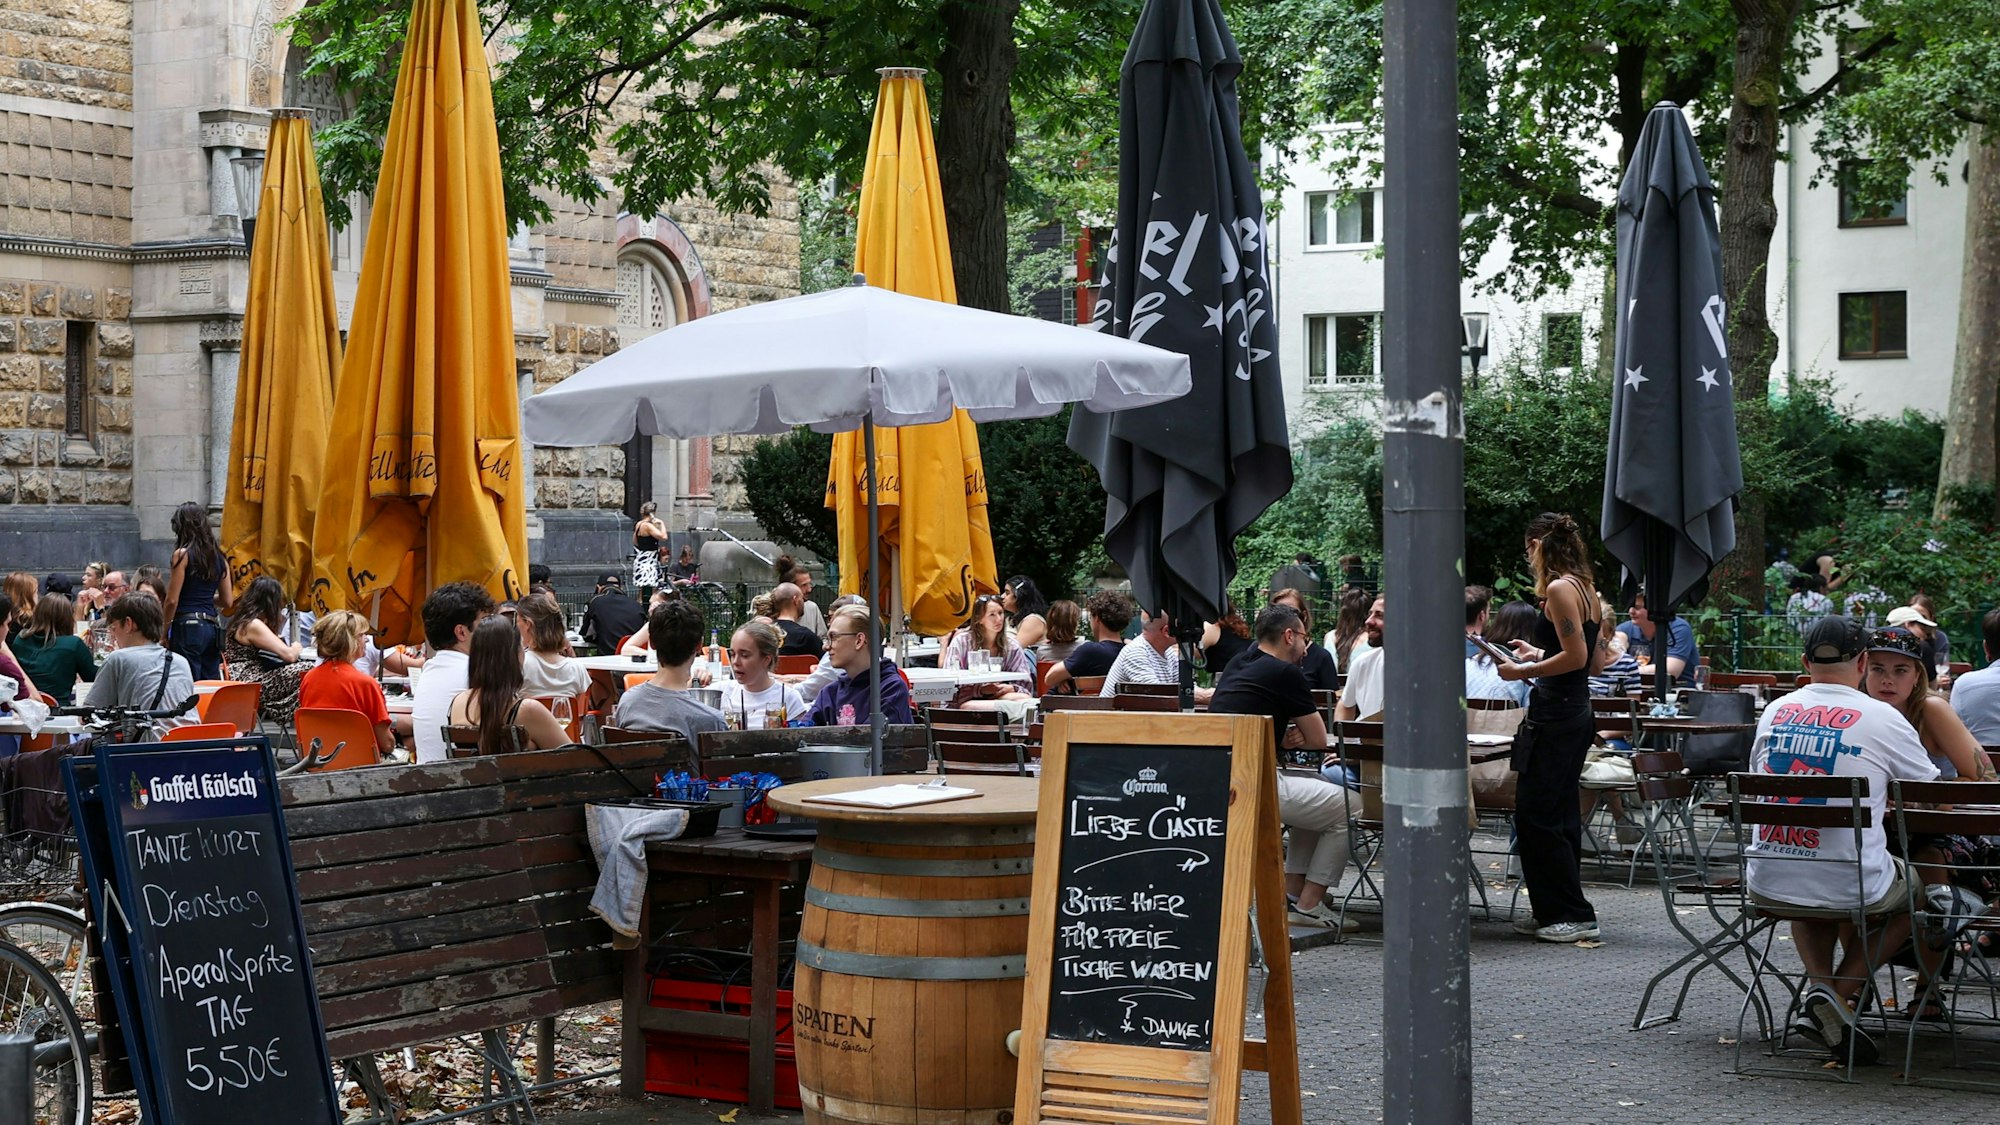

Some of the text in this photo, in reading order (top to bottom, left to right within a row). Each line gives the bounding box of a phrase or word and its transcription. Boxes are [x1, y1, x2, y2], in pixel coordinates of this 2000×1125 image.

[1771, 703, 1862, 730] DYNO
[1794, 727, 1816, 735] TOUR
[150, 770, 258, 804] Gaffel Kölsch
[1122, 777, 1169, 797] Corona
[1148, 795, 1225, 840] GÄSTE
[127, 826, 262, 870] TANTE KURT
[1759, 824, 1821, 849] VANS
[1773, 845, 1818, 858] LEGENDS
[142, 883, 270, 928] Dienstag
[1060, 922, 1103, 949] FÜR
[1058, 954, 1213, 982] TISCHE WARTEN
[196, 994, 253, 1038] TAG
[797, 1003, 876, 1039] SPATEN
[840, 1040, 876, 1054] Spaten!
[185, 1036, 288, 1096] 5,50€
